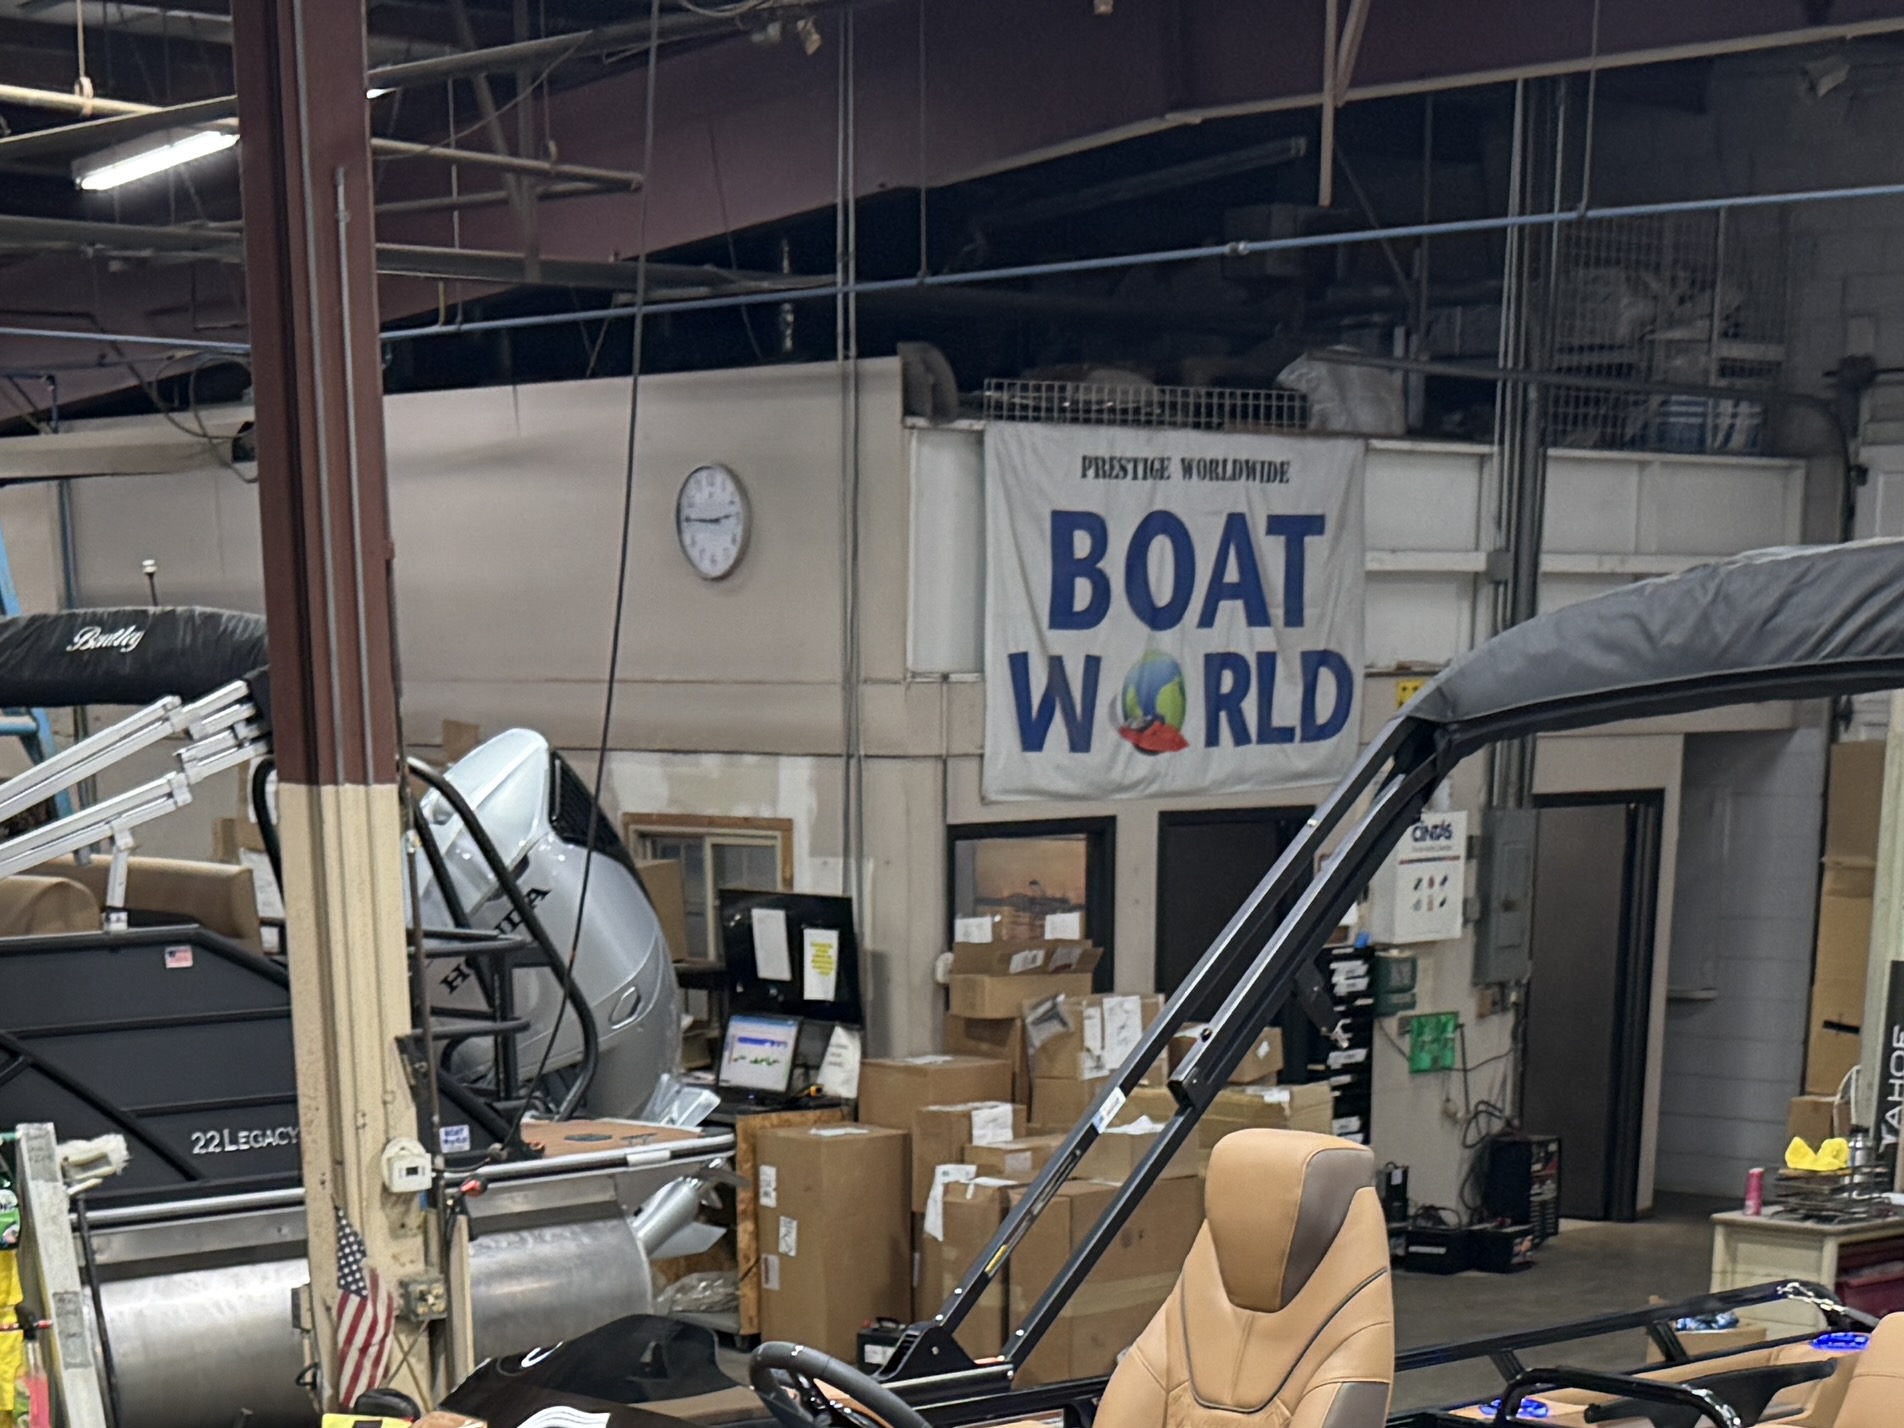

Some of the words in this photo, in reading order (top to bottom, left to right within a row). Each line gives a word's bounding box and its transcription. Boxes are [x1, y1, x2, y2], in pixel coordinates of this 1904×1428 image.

[1081, 455, 1172, 481] PRESTIGE
[1180, 457, 1291, 484] WORLDWIDE
[1048, 509, 1326, 632] BOAT
[66, 625, 146, 653] Bentley
